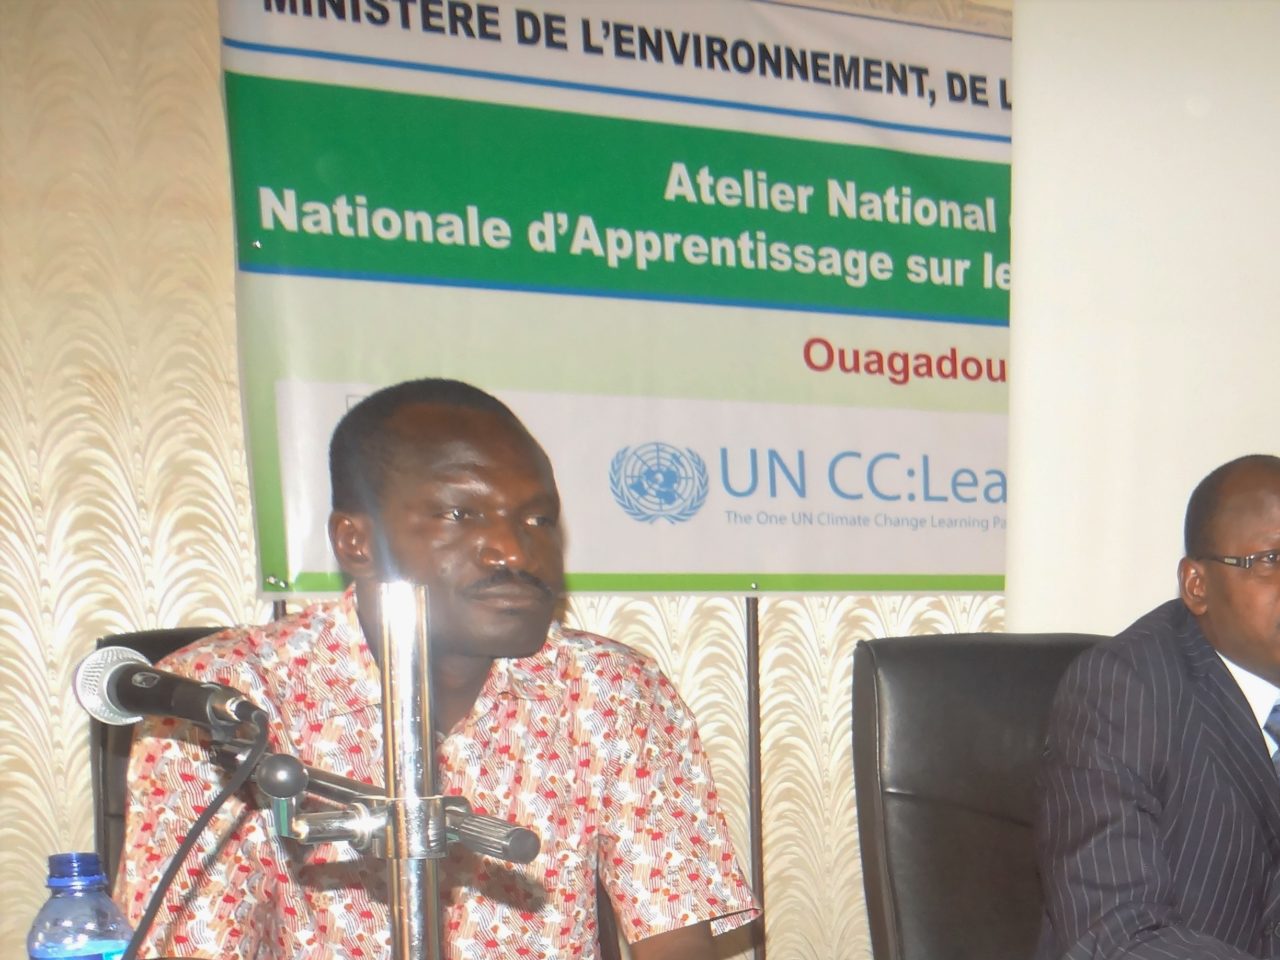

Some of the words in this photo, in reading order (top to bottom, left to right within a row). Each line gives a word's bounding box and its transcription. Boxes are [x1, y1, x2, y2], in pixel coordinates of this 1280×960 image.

[515, 9, 568, 50] DE
[582, 18, 936, 107] L'ENVIRONNEMENT,
[946, 70, 988, 107] DE
[664, 161, 813, 214] Atelier
[827, 178, 996, 233] National
[259, 186, 511, 249] Nationale
[527, 211, 893, 288] d'Apprentissage
[906, 253, 971, 286] sur
[803, 337, 1006, 385] Ouagadou
[720, 447, 806, 498] UN
[828, 451, 1007, 504] CC:Lea
[725, 510, 752, 525] The
[757, 511, 787, 526] One
[791, 512, 813, 526] UN
[817, 513, 870, 527] Climate
[874, 514, 927, 531] Change
[931, 515, 989, 531] Learning
